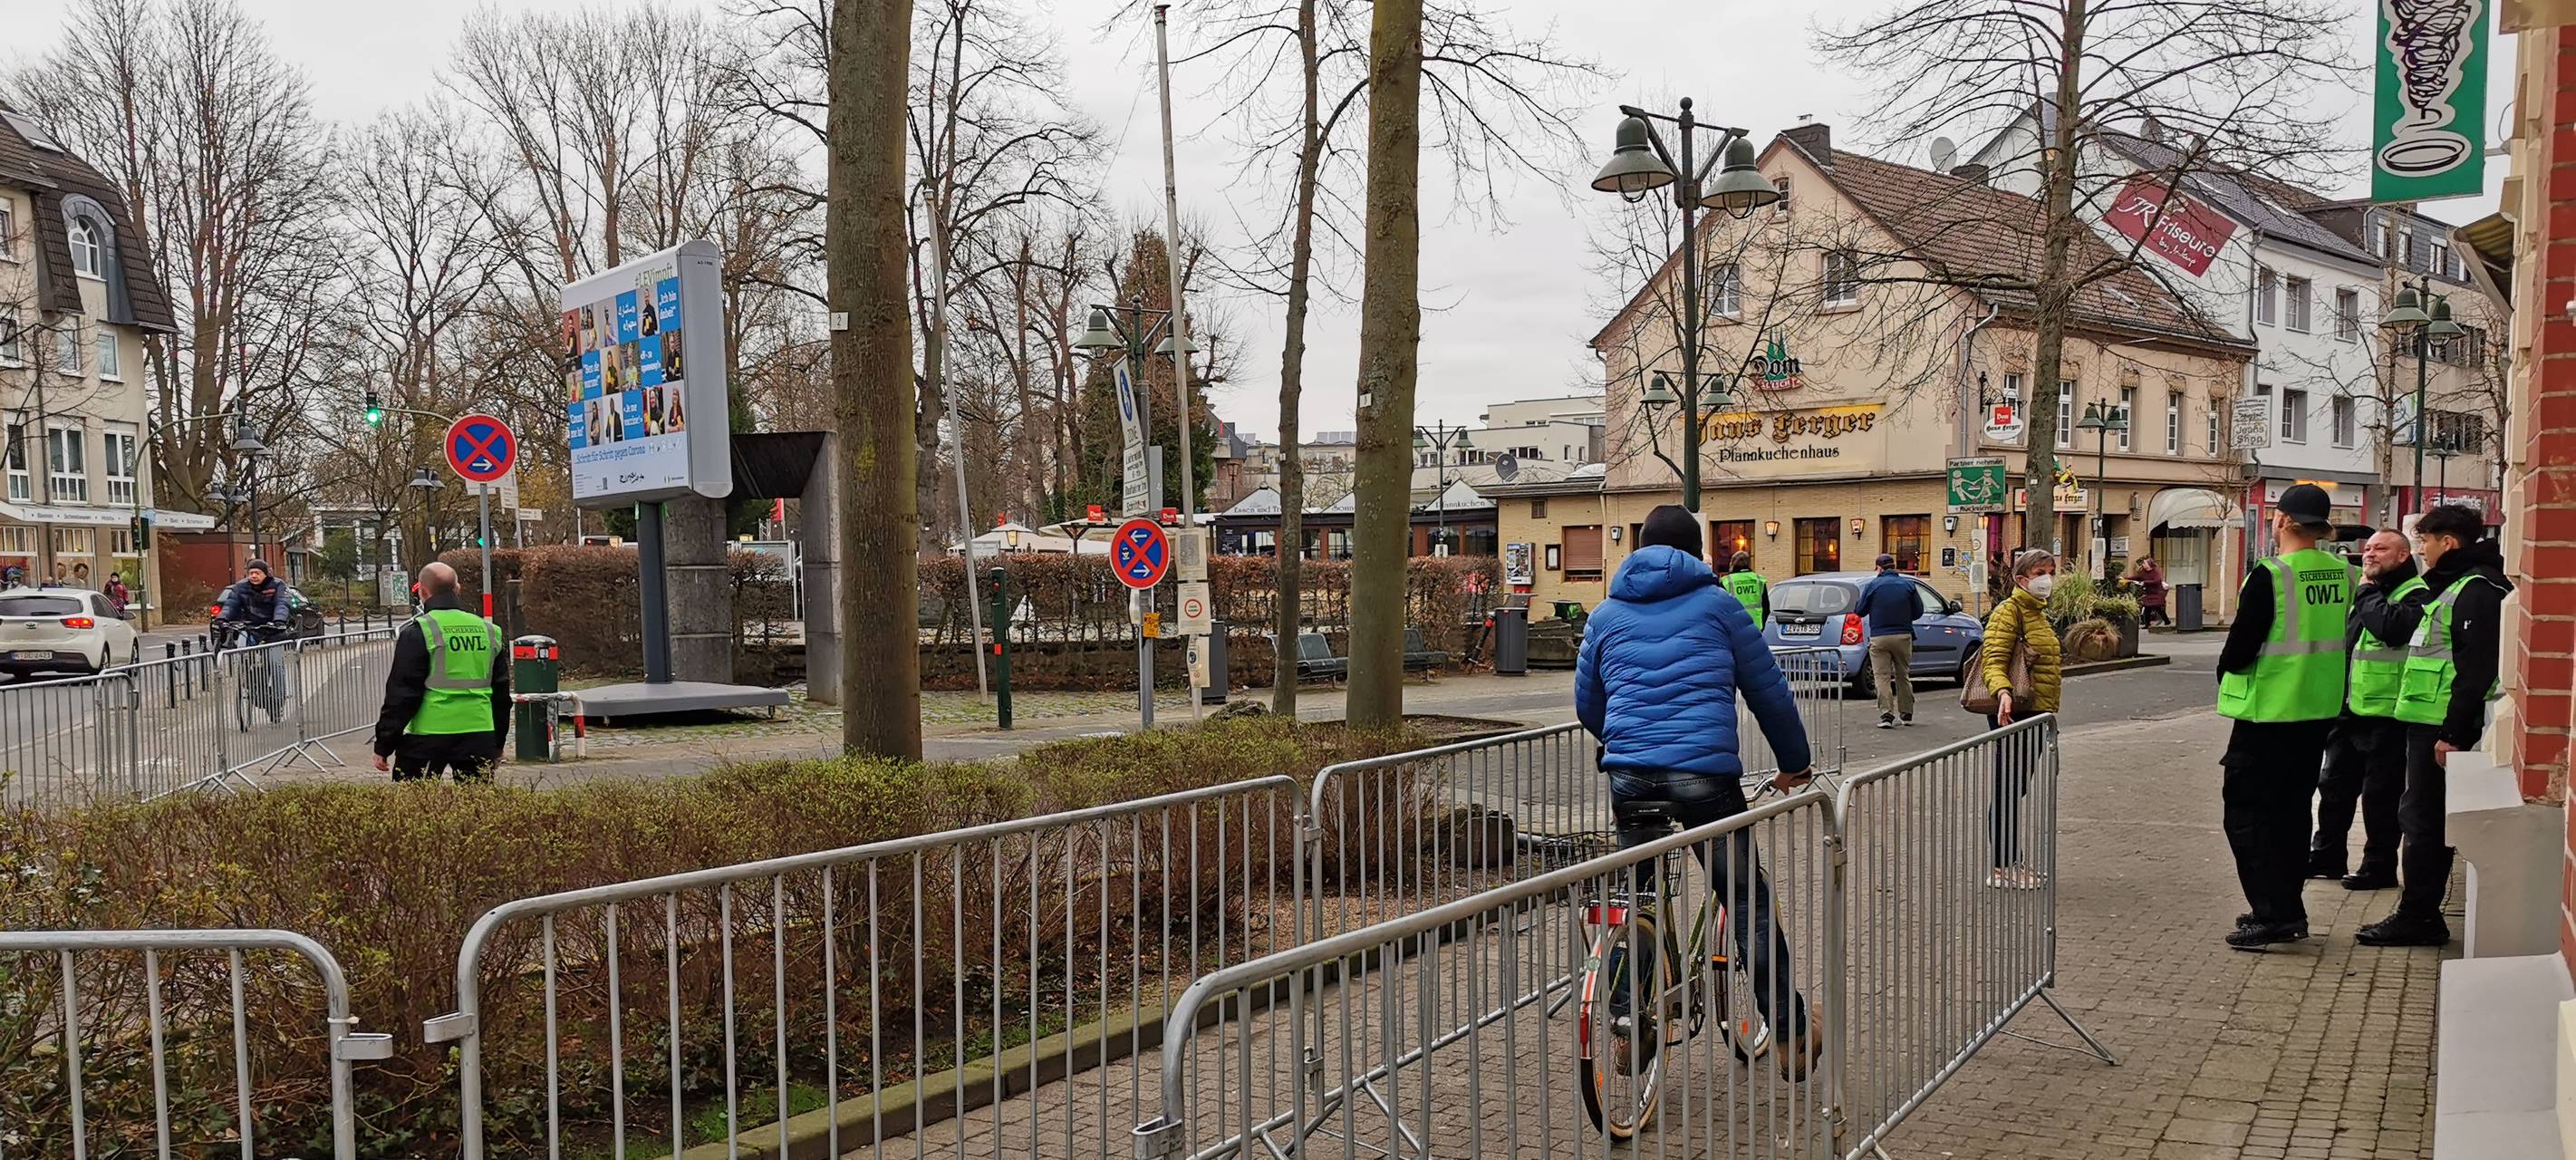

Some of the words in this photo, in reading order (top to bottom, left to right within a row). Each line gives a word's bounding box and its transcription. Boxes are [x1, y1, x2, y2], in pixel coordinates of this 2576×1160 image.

[2156, 214, 2216, 258] Friseure
[2236, 435, 2263, 445] Shop
[2299, 571, 2345, 583] SICHERHEIT
[1736, 585, 1757, 594] OWL
[2305, 584, 2345, 605] OWL
[449, 635, 487, 652] OWL
